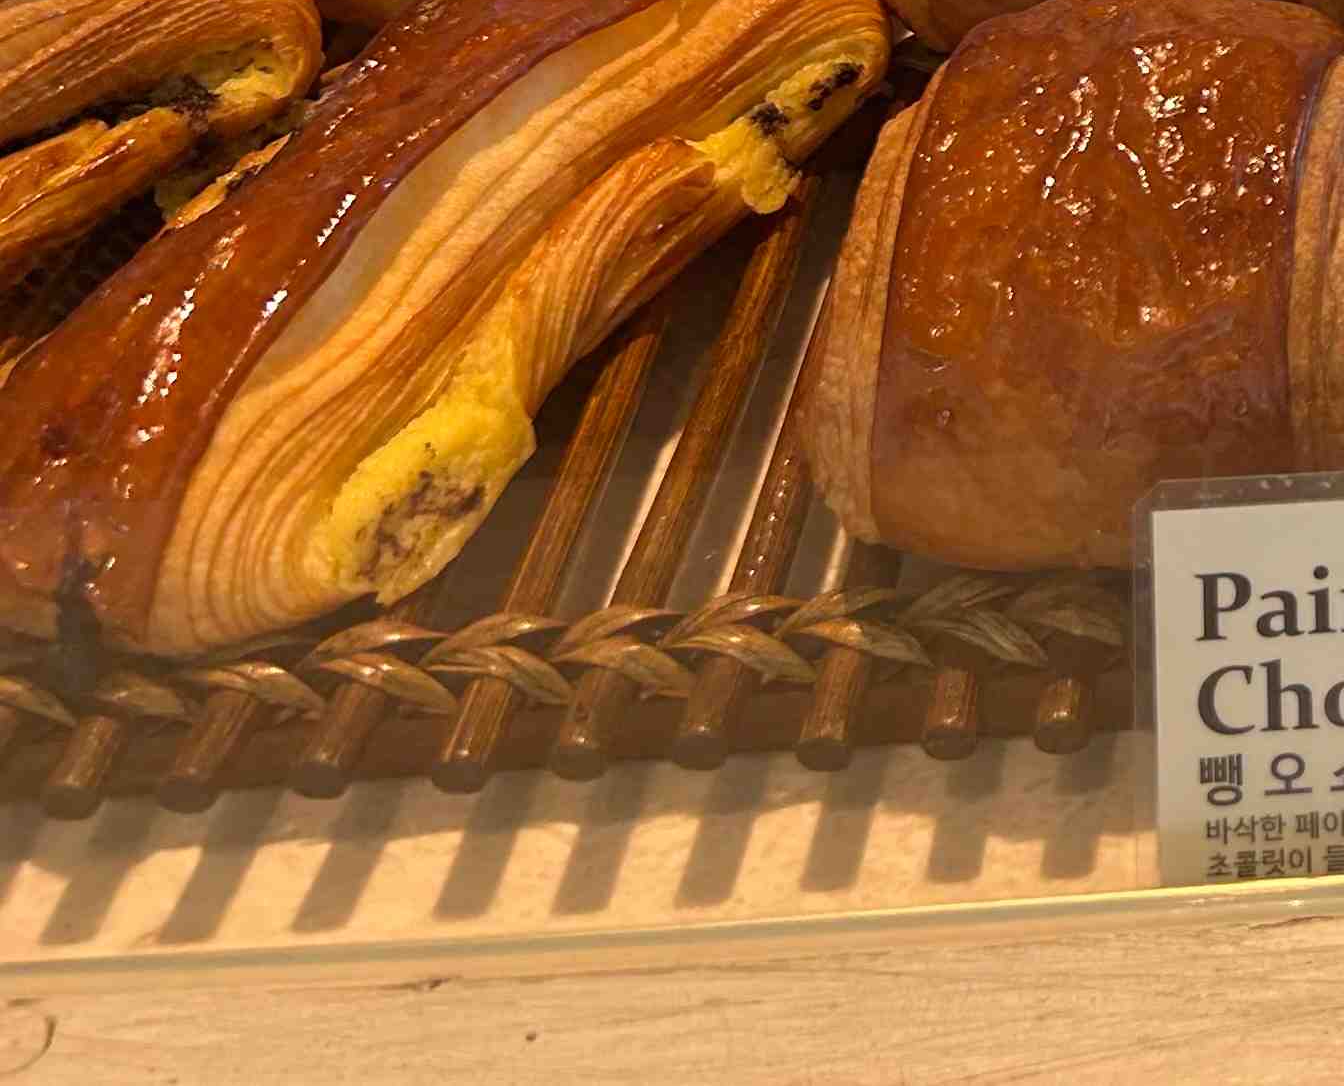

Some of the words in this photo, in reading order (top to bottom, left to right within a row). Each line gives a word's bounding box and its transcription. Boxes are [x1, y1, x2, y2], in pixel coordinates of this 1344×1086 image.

[1199, 752, 1244, 807] 뺑
[1263, 752, 1313, 797] 오
[1206, 813, 1287, 845] 바삭한
[1206, 847, 1313, 879] 초콜릿이
